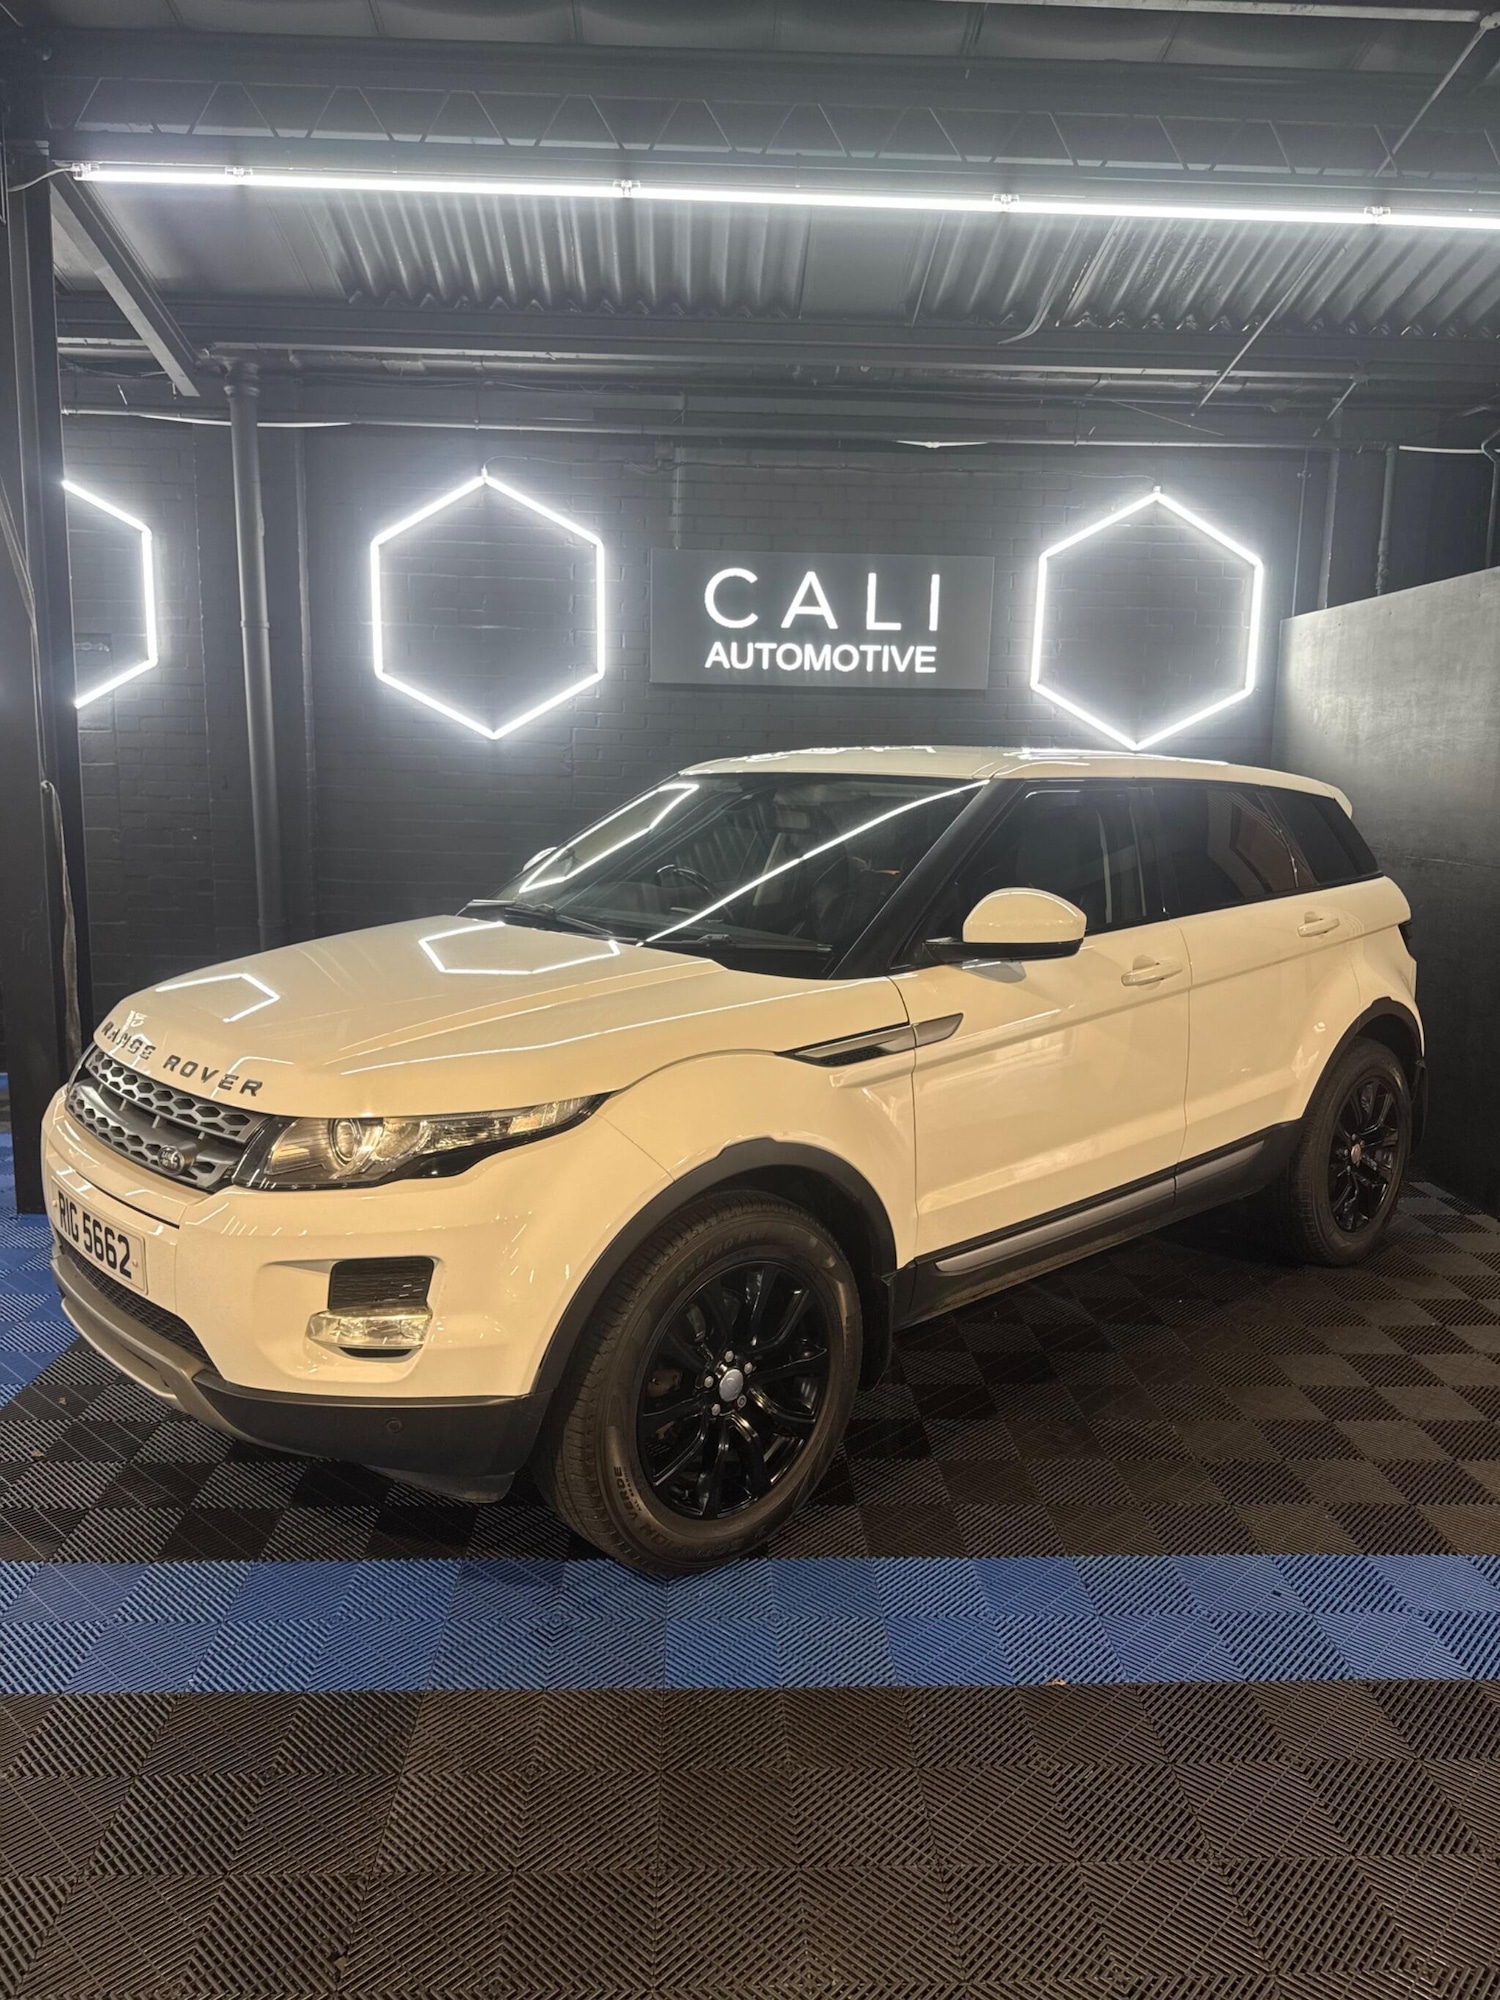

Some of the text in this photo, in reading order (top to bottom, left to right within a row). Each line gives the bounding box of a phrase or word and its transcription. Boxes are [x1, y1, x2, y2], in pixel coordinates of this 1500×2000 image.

[704, 567, 940, 631] CALI
[704, 641, 937, 673] AUTOMOTIVE
[101, 1021, 263, 1097] RANGE ROVER
[58, 1190, 132, 1280] RIG 5662
[613, 1466, 638, 1520] VERDE
